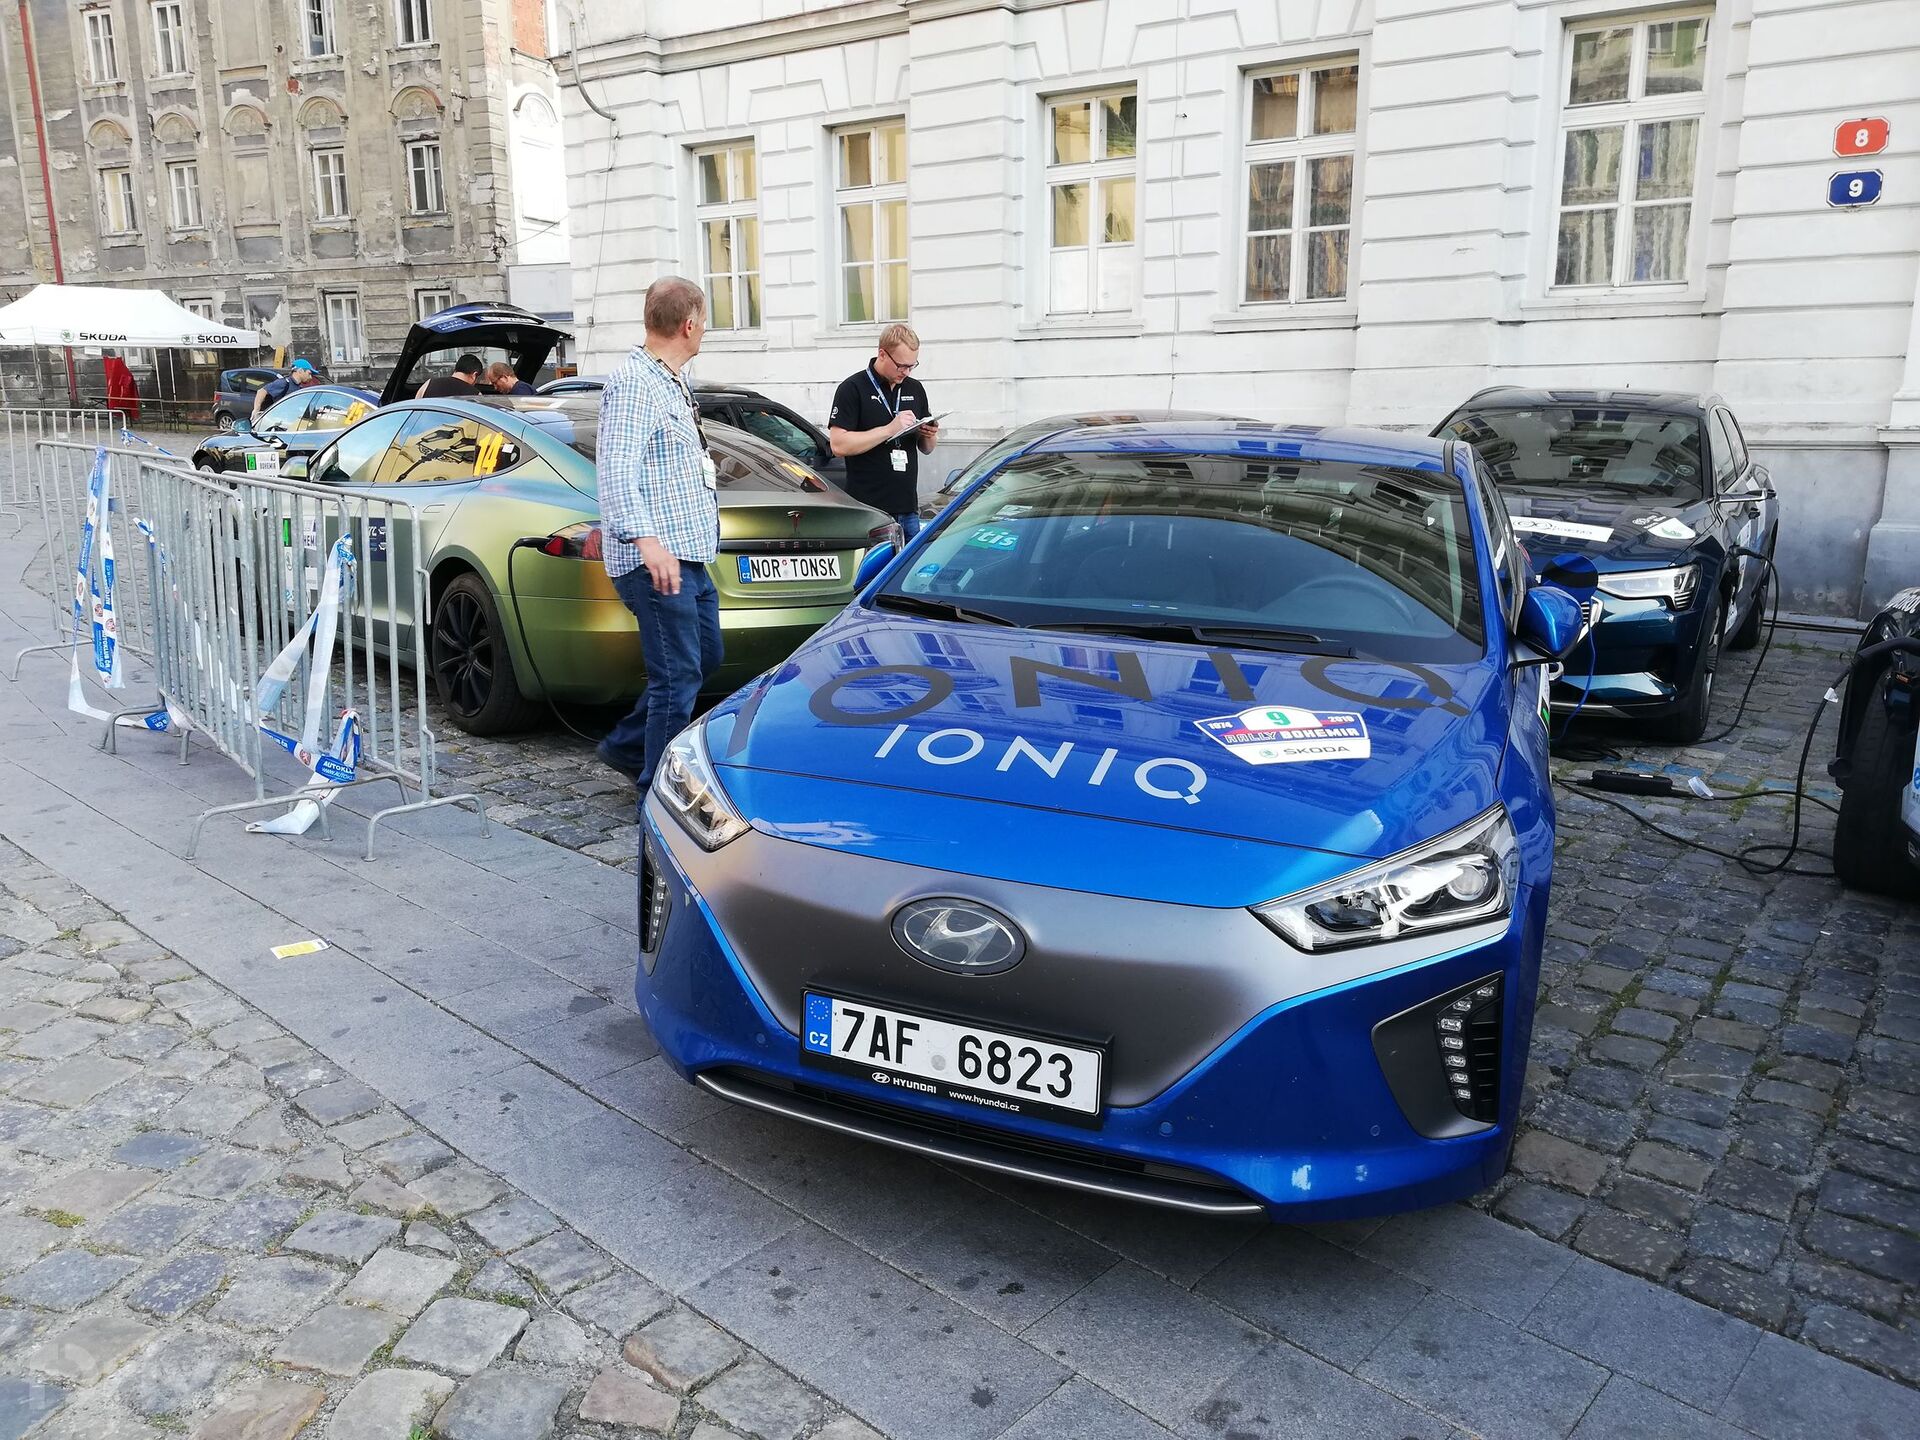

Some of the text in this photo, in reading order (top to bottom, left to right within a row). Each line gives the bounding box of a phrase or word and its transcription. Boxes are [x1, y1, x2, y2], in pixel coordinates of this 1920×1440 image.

[1854, 128, 1869, 147] 8
[1848, 178, 1863, 197] 9
[473, 431, 504, 477] 14
[765, 540, 826, 549] TESLA
[750, 557, 838, 580] NOR TONSK
[727, 653, 1470, 758] IONIQ
[1266, 711, 1291, 727] 9
[1225, 727, 1360, 744] RALLY BOHEMIA
[874, 724, 1207, 805] IONIQ
[809, 1031, 828, 1047] CZ
[842, 1007, 1073, 1099] 7AF 6823
[892, 1077, 1020, 1113] HYUNDAI www.hyundai.cz
